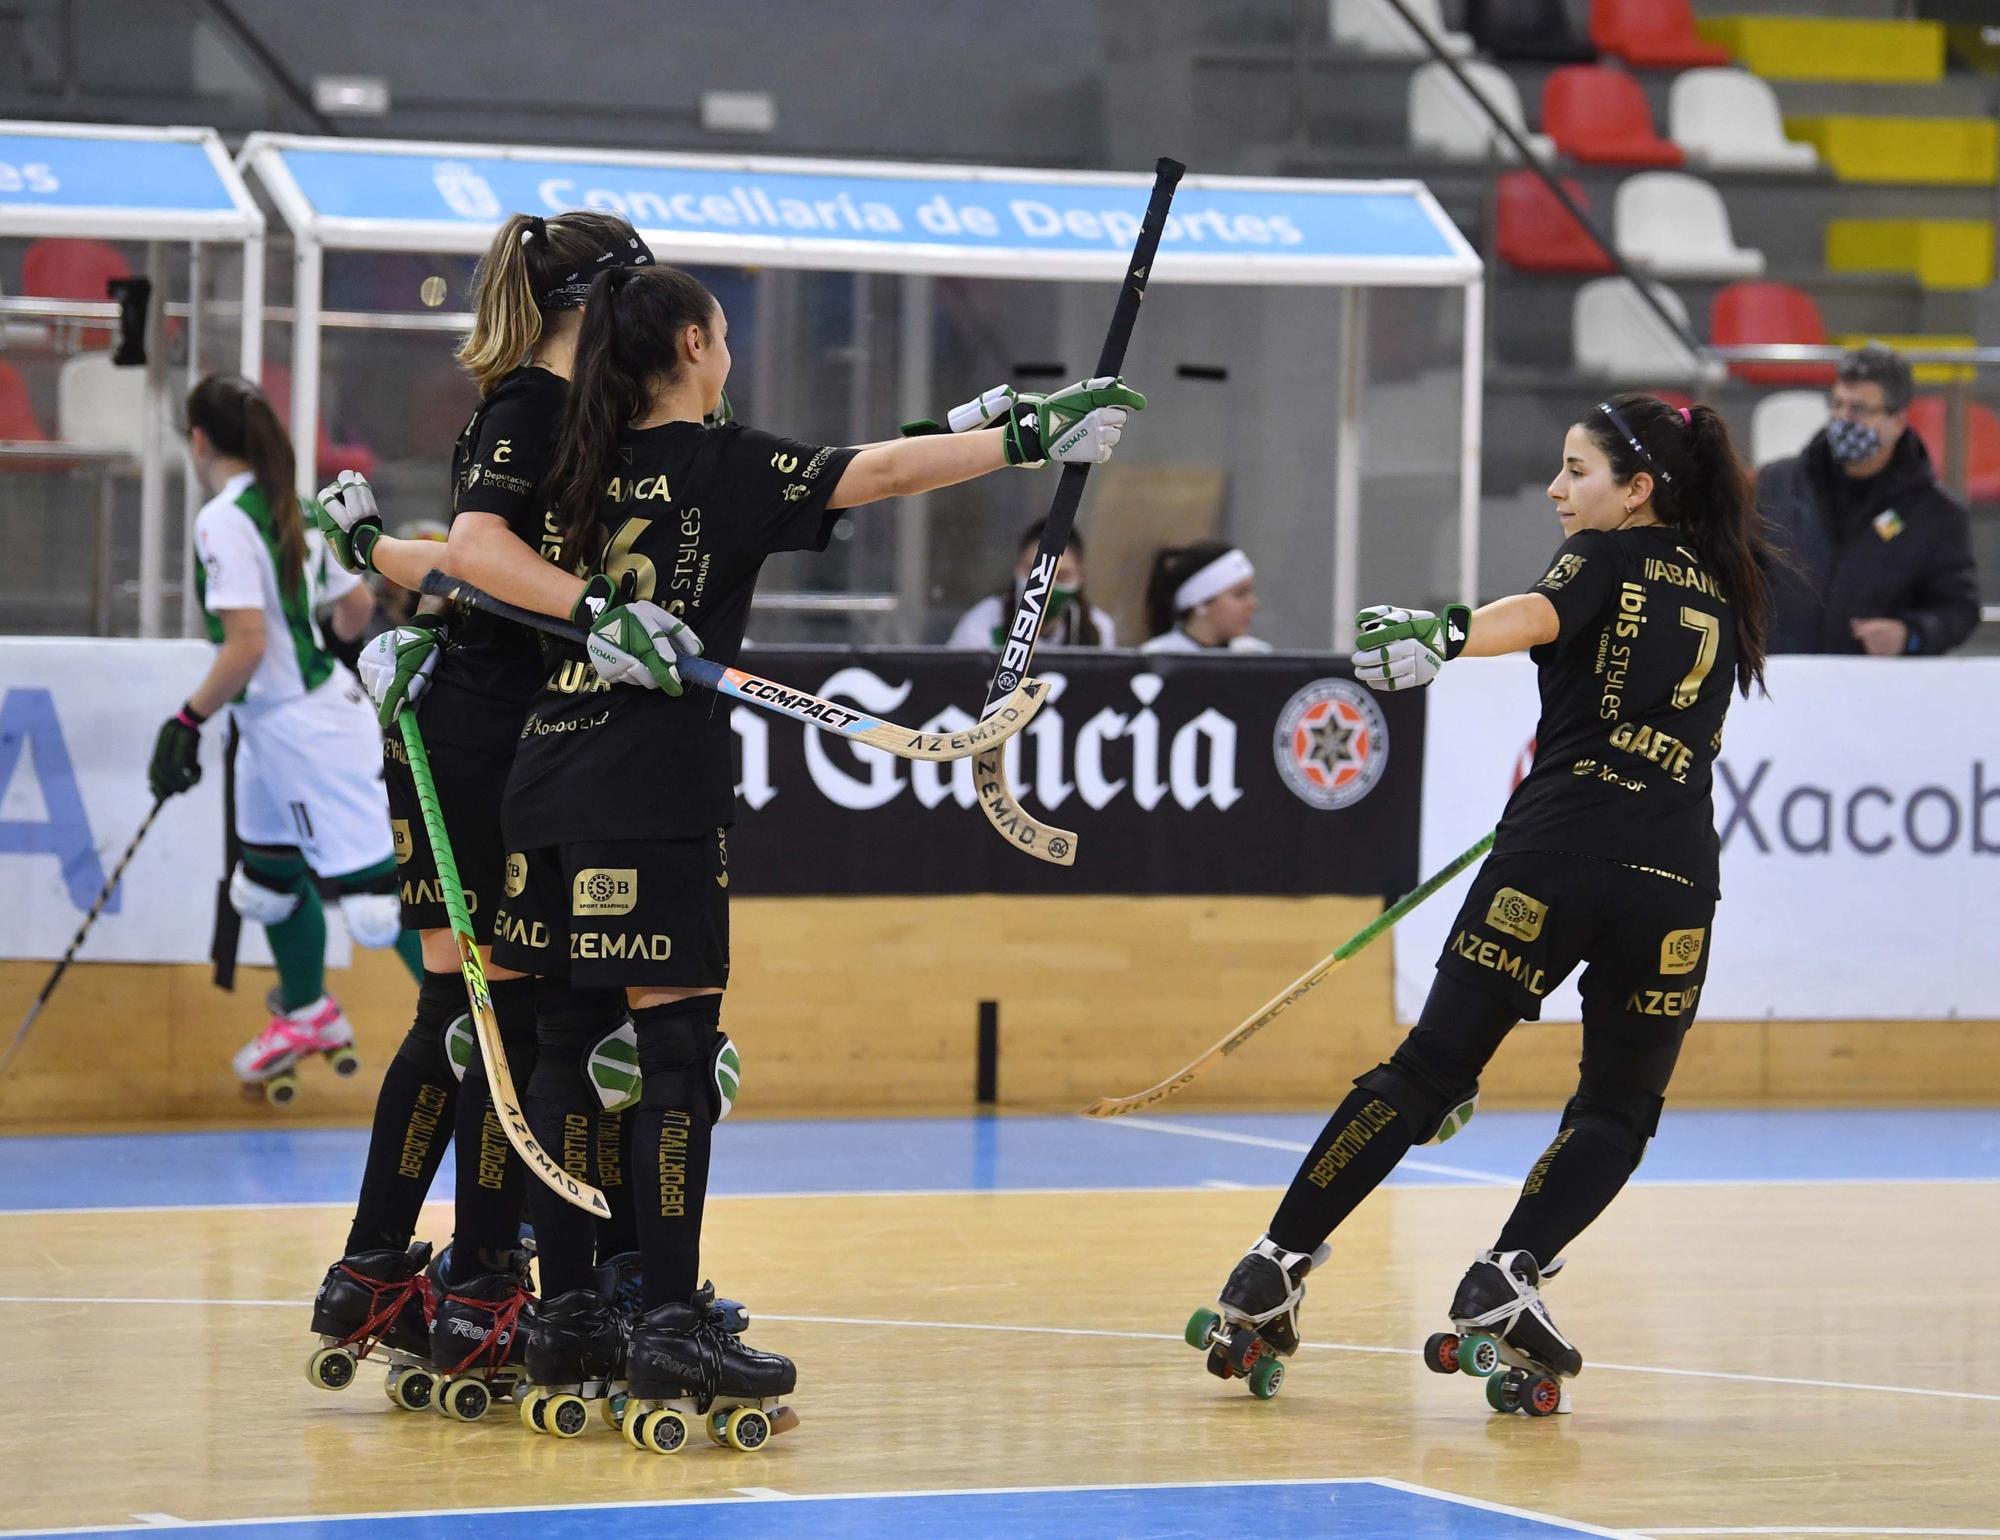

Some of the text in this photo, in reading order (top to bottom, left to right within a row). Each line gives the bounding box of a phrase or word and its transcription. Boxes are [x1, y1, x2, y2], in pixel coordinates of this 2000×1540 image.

[537, 178, 1303, 249] Concellaría de Deportes
[602, 516, 657, 602] 6
[1616, 582, 1648, 639] ibis
[590, 645, 618, 665] AZEMAD
[1671, 606, 1720, 710] 7
[740, 679, 860, 728] COMPACT
[399, 1112, 438, 1178] DEPORTIVO
[504, 1102, 579, 1196] AZEMAD
[659, 1127, 688, 1217] DEPORTIVO
[1307, 1119, 1374, 1189] DEPORTIVO
